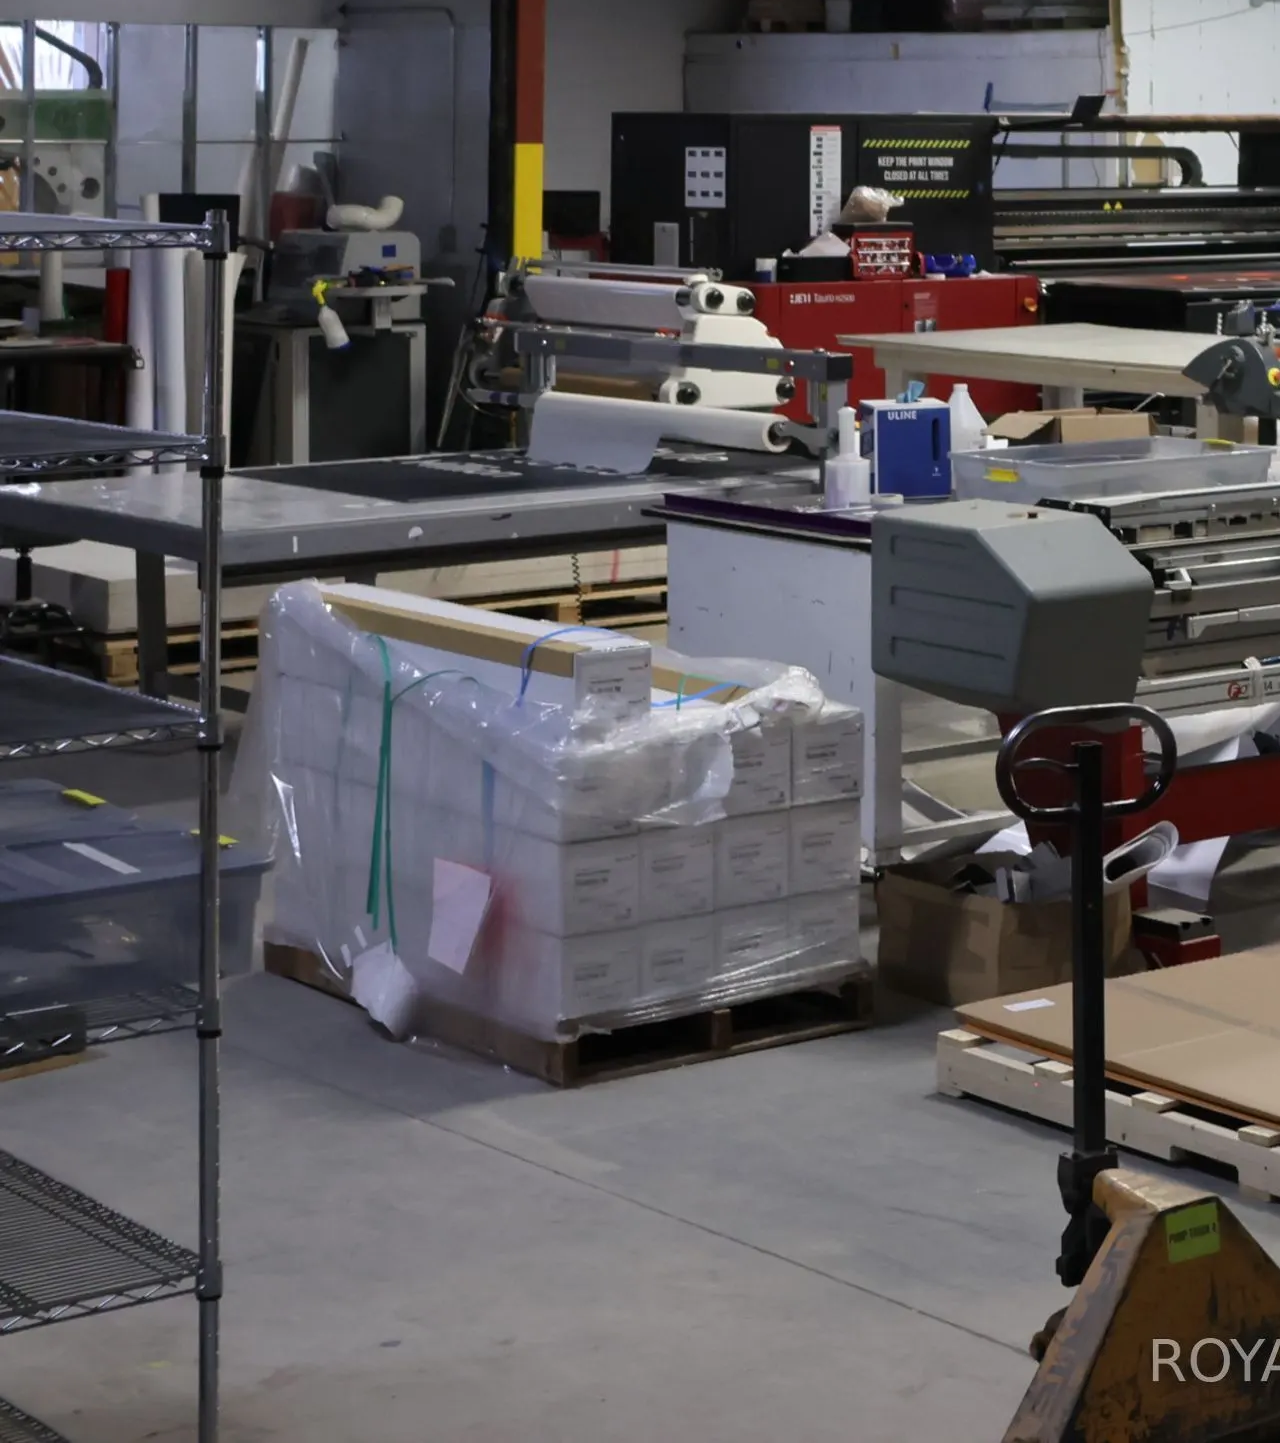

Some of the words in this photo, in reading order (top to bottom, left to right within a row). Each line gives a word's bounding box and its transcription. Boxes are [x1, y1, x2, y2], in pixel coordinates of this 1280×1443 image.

[878, 156, 894, 166] KEEP
[895, 156, 907, 166] THE
[909, 170, 916, 181] AT
[917, 170, 929, 181] ALL
[888, 410, 917, 421] ULINE
